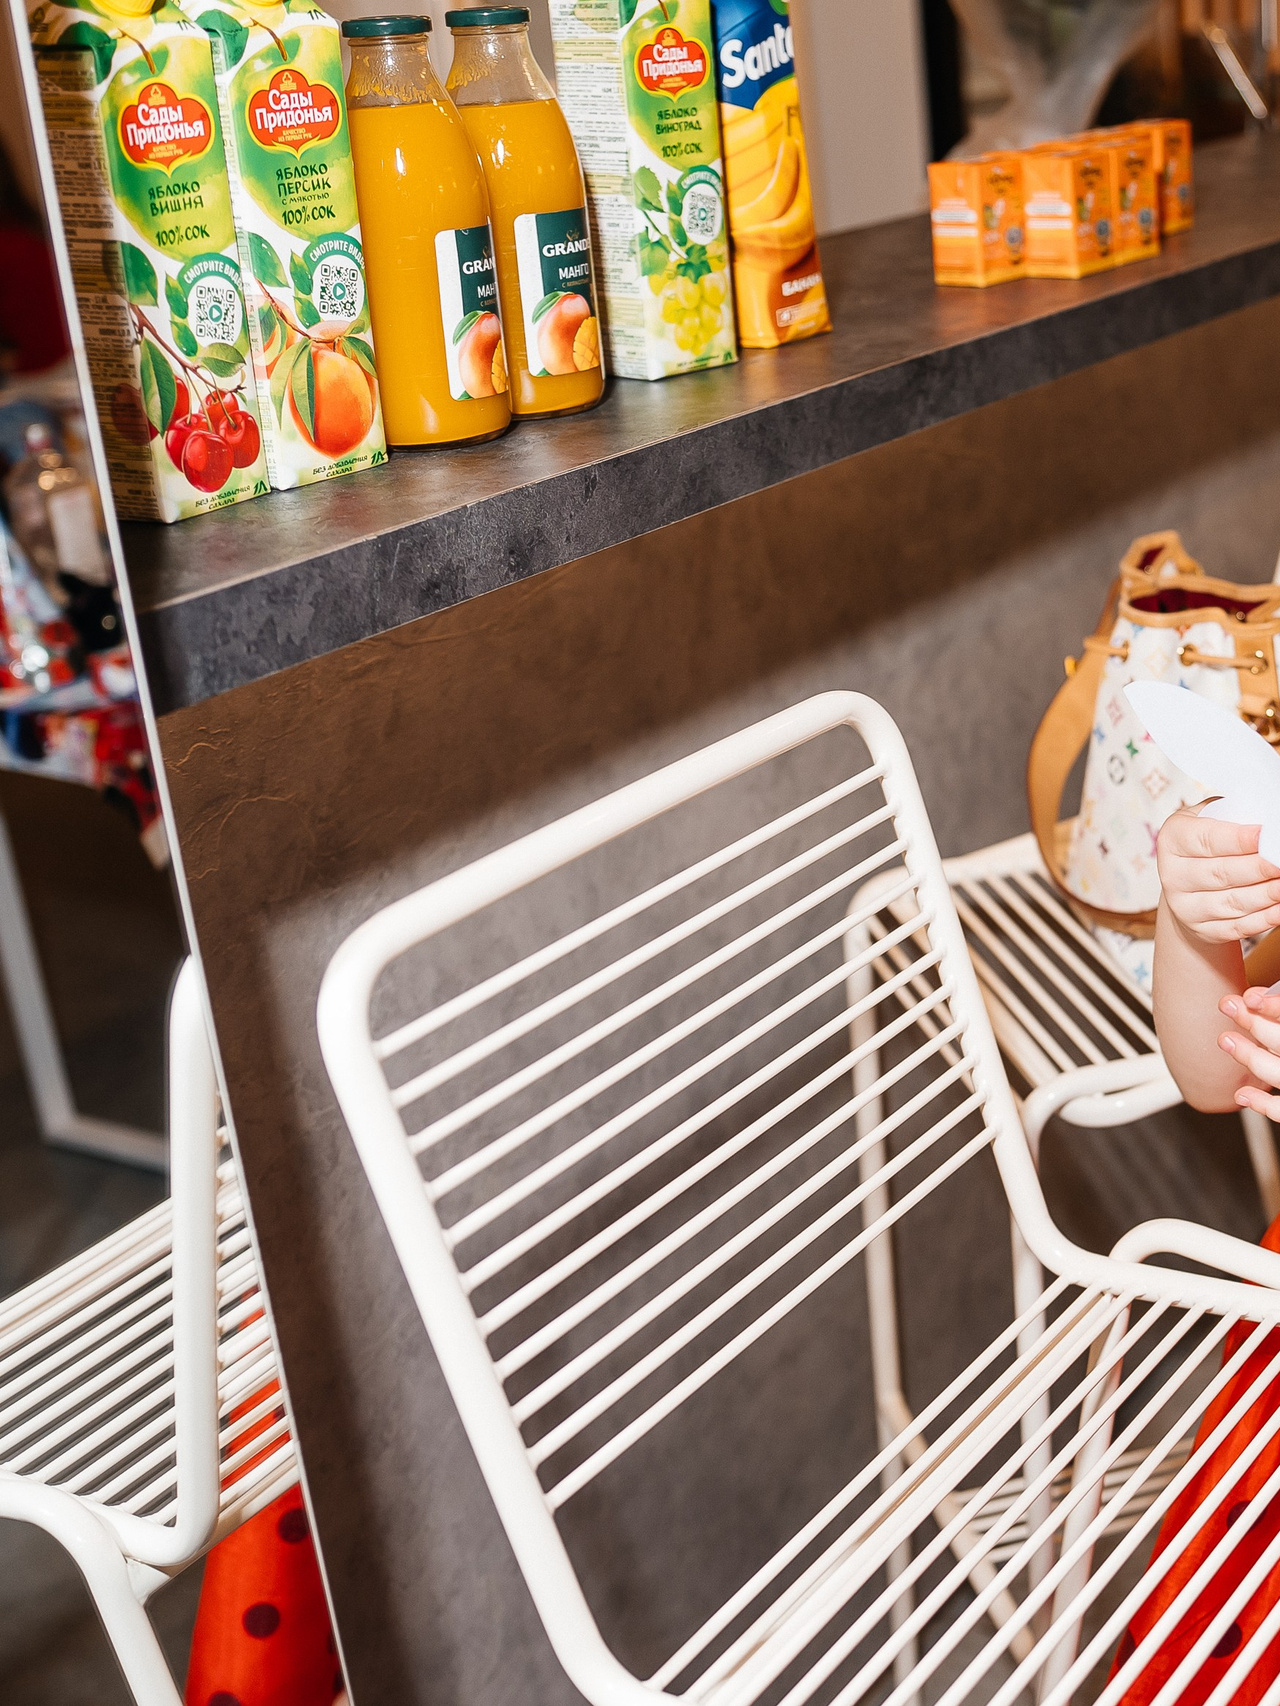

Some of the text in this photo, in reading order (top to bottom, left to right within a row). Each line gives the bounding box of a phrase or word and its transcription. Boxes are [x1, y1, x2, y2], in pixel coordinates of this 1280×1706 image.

[653, 44, 688, 61] Сады
[642, 58, 703, 80] Придонья
[268, 89, 313, 111] Сады
[137, 104, 183, 126] Сады
[255, 105, 333, 133] Придонья
[657, 107, 697, 121] ЯБЛОКО
[126, 120, 205, 149] Придонья
[655, 120, 702, 135] ВИНОГРАД
[276, 163, 328, 181] ЯБЛОКО
[148, 181, 201, 201] ЯБЛОКО
[278, 177, 332, 197] ПЕРСИК
[150, 195, 204, 217] ВИШНЯ
[289, 192, 330, 204] МЯКОТЬЮ
[309, 240, 348, 262] СМОТРИТЕ
[183, 260, 224, 284] СМОТРИТЕ
[558, 262, 589, 281] МАНГО
